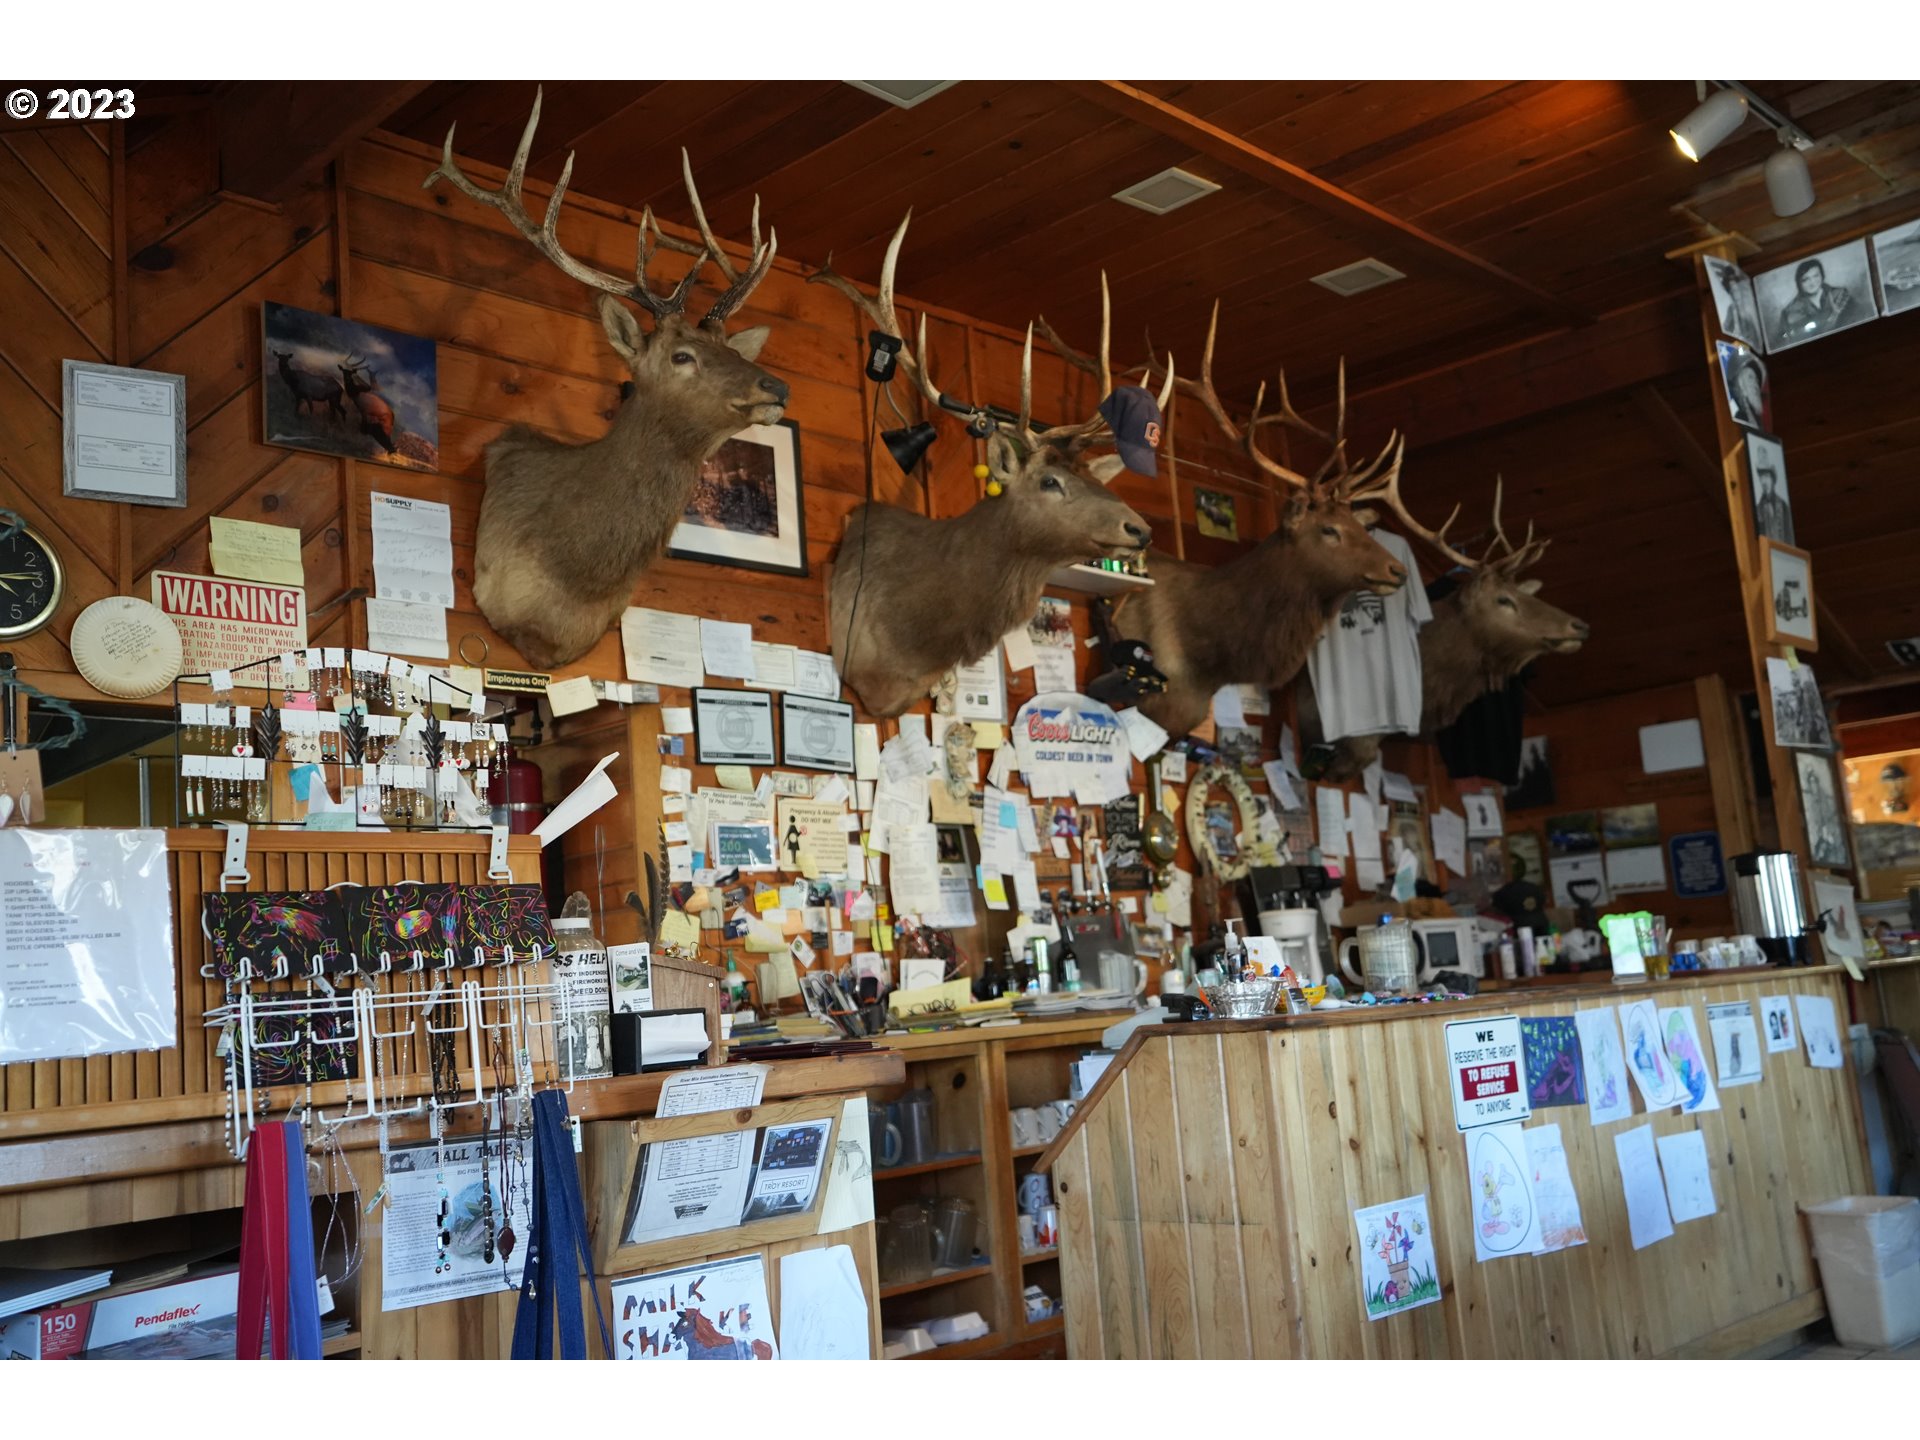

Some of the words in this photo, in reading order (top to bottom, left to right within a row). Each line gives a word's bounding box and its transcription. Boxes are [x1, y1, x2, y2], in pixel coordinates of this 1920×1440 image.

[10, 537, 16, 552] 1
[24, 552, 36, 567] 2
[32, 571, 44, 588] 3
[26, 592, 38, 607] 4
[163, 577, 297, 625] WARNING
[10, 604, 22, 620] 5
[172, 618, 186, 628] HIS
[192, 620, 214, 630] AREA
[220, 623, 238, 632] HAS
[242, 626, 294, 638] MICROWAVE
[178, 629, 216, 640] ERATING
[222, 633, 269, 646] EQUIPMENT
[275, 638, 301, 648] WHICH
[182, 638, 192, 647] BE
[196, 640, 248, 652] HAZARDOUS
[253, 646, 262, 654] TO
[184, 658, 196, 666] OR
[201, 659, 228, 668] OTHER
[196, 650, 244, 661] IMPLANTED
[488, 673, 531, 685] Employees
[532, 676, 550, 686] Only
[1028, 712, 1070, 742] Coors
[1070, 725, 1116, 744] LIGHT
[1036, 750, 1065, 762] COLDEST
[1068, 752, 1084, 762] BEER
[1086, 753, 1094, 762] IN
[1096, 753, 1113, 763] TOWN
[720, 840, 740, 852] 200
[1476, 1030, 1494, 1043] WE
[1454, 1049, 1484, 1064] RESERVE
[1485, 1047, 1498, 1060] THE
[1499, 1044, 1516, 1058] RIGHT
[1468, 1068, 1479, 1082] TO
[1480, 1064, 1510, 1080] REFUSE
[1476, 1080, 1506, 1097] SERVICE
[1475, 1103, 1484, 1115] TO
[1486, 1098, 1512, 1114] ANYONE
[432, 1148, 470, 1164] TALL
[764, 1182, 780, 1190] TROY
[782, 1180, 805, 1188] RESORT
[623, 1275, 706, 1320] MILK
[44, 1313, 76, 1334] 150
[135, 1304, 200, 1328] Pendaflex
